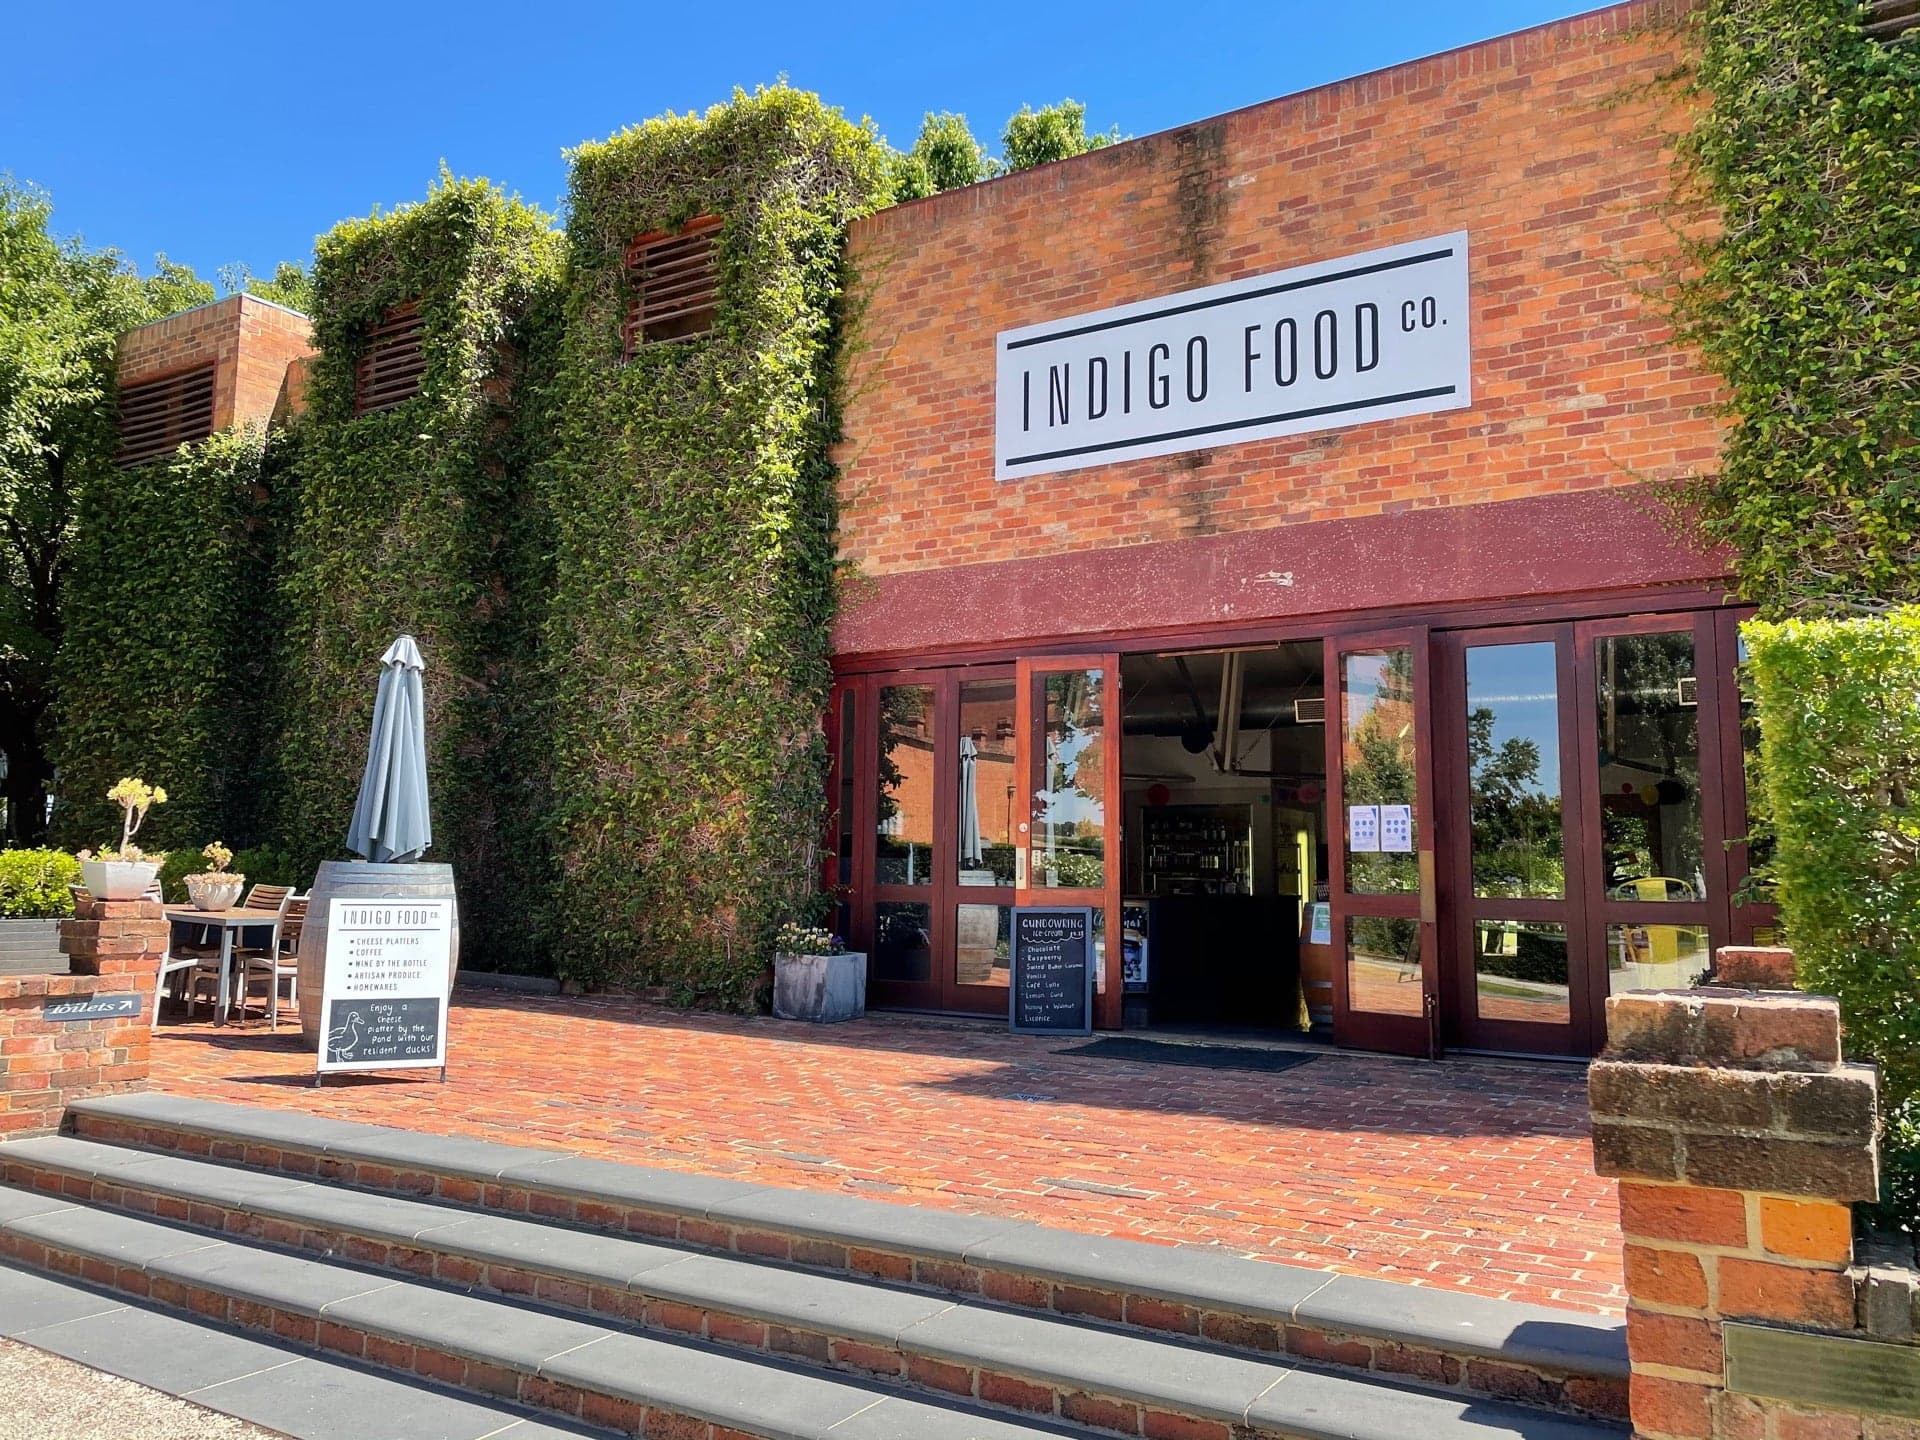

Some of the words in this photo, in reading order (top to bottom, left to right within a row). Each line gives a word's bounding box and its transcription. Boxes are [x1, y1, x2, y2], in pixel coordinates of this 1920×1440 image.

[1023, 335, 1208, 432] INDIGO
[1245, 302, 1380, 393] FOOD
[1401, 296, 1448, 332] CO.
[344, 910, 391, 925] INDIGO
[398, 910, 427, 925] FOOD
[1022, 918, 1083, 929] GUNDOWRING
[356, 937, 383, 945] CHEESE
[386, 937, 419, 945] PLATTERS
[356, 948, 382, 956] COFFEE
[1028, 945, 1060, 953] Chocolate
[1028, 954, 1062, 962] Raspberry
[354, 971, 385, 979] ARTISAN
[388, 971, 421, 979] PRODUCE
[353, 983, 398, 991] HOMEWARES
[49, 1002, 116, 1014] Toilets
[370, 1003, 393, 1016] Enjoy
[1025, 1014, 1050, 1022] Licorice
[367, 1025, 393, 1034] platter
[398, 1026, 408, 1034] by
[363, 1047, 397, 1055] resident
